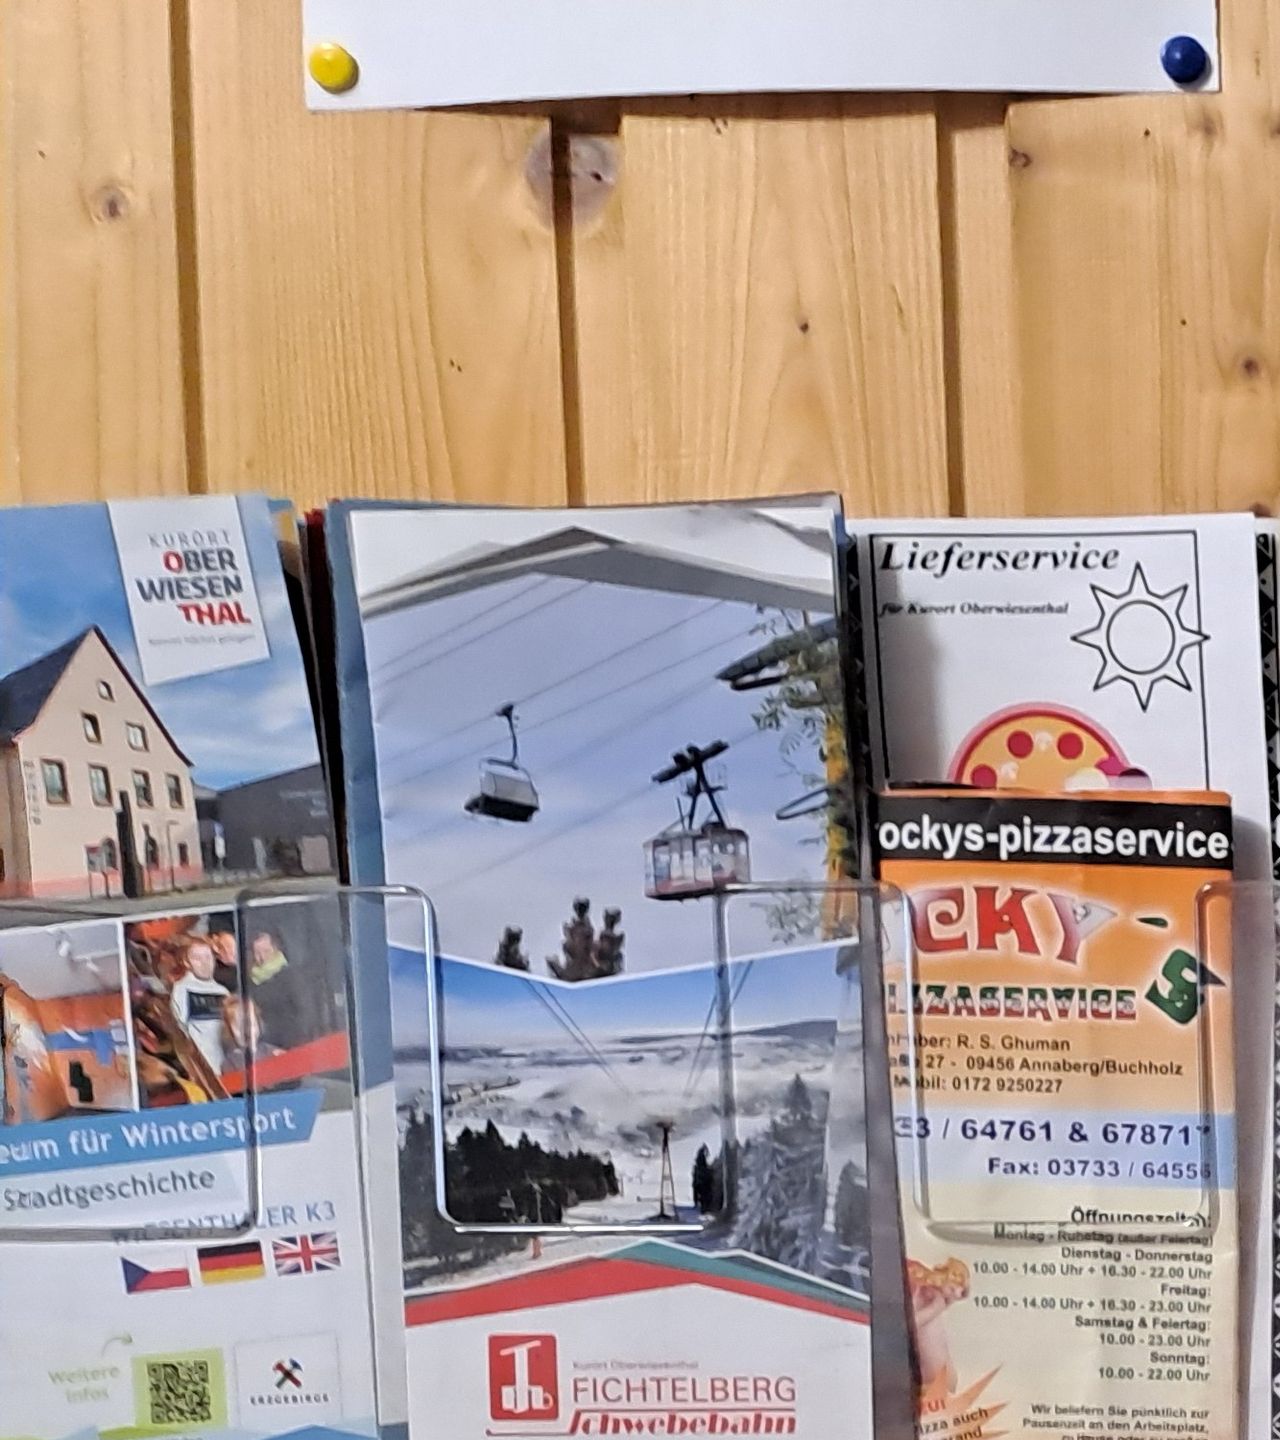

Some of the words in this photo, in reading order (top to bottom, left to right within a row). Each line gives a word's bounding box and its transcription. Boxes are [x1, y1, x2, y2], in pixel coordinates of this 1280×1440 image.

[147, 530, 231, 547] KURORT
[163, 548, 239, 573] OBER
[879, 541, 1121, 579] Lieferservice
[135, 574, 243, 602] WIESEN
[176, 601, 252, 625] THAL
[880, 602, 903, 618] für
[907, 602, 956, 615] Kurort
[959, 602, 1070, 616] Oberwiesenthal
[957, 1034, 974, 1049] R.
[980, 1034, 996, 1050] S.
[1001, 1034, 1070, 1051] Ghuman
[925, 1054, 945, 1069] 27
[966, 1055, 1015, 1071] 09456
[1019, 1057, 1183, 1077] Annaberg/Buchholz
[952, 1076, 991, 1091] 0172
[996, 1077, 1063, 1094] 9250227
[69, 1129, 112, 1156] für
[121, 1106, 297, 1149] Wintersport
[961, 1118, 1052, 1142] 64761
[1068, 1123, 1089, 1143] &
[987, 1156, 1039, 1176] Fax:
[1047, 1158, 1121, 1177] 03733
[4, 1167, 216, 1211] Stadtgeschichte
[305, 1201, 337, 1222] K3
[1061, 1247, 1122, 1262] Dienstag
[1135, 1248, 1213, 1264] Donnerstag
[973, 1261, 1009, 1274] 10.00
[1022, 1263, 1057, 1276] 14.00
[1060, 1263, 1084, 1277] Uhr
[1101, 1265, 1137, 1278] 16.30
[1149, 1266, 1184, 1279] 22.00
[1187, 1267, 1213, 1280] Uhr
[1160, 1283, 1212, 1299] Freitag:
[973, 1296, 1009, 1308] 10.00
[1022, 1297, 1057, 1310] 14.00
[1061, 1297, 1084, 1310] Uhr
[1149, 1300, 1184, 1313] 23.00
[1187, 1301, 1212, 1314] Uhr
[1074, 1315, 1134, 1331] Samstag
[1152, 1317, 1211, 1332] Feiertag:
[1099, 1333, 1136, 1345] 10.00
[1148, 1335, 1183, 1347] 23.00
[1186, 1335, 1211, 1348] Uhr
[1149, 1351, 1210, 1366] Sonntag:
[48, 1364, 120, 1385] Weitere
[1099, 1368, 1135, 1380] 10.00
[1147, 1369, 1182, 1381] 22.00
[1185, 1369, 1211, 1382] Uhr
[66, 1386, 110, 1404] Infos
[572, 1376, 796, 1403] FICHTELBERG
[249, 1394, 330, 1407] ERZGEBIRGE
[952, 1407, 989, 1427] auch
[1031, 1403, 1052, 1415] Wir
[1108, 1405, 1128, 1417] Sie
[1088, 1421, 1104, 1430] an
[1107, 1420, 1130, 1430] den
